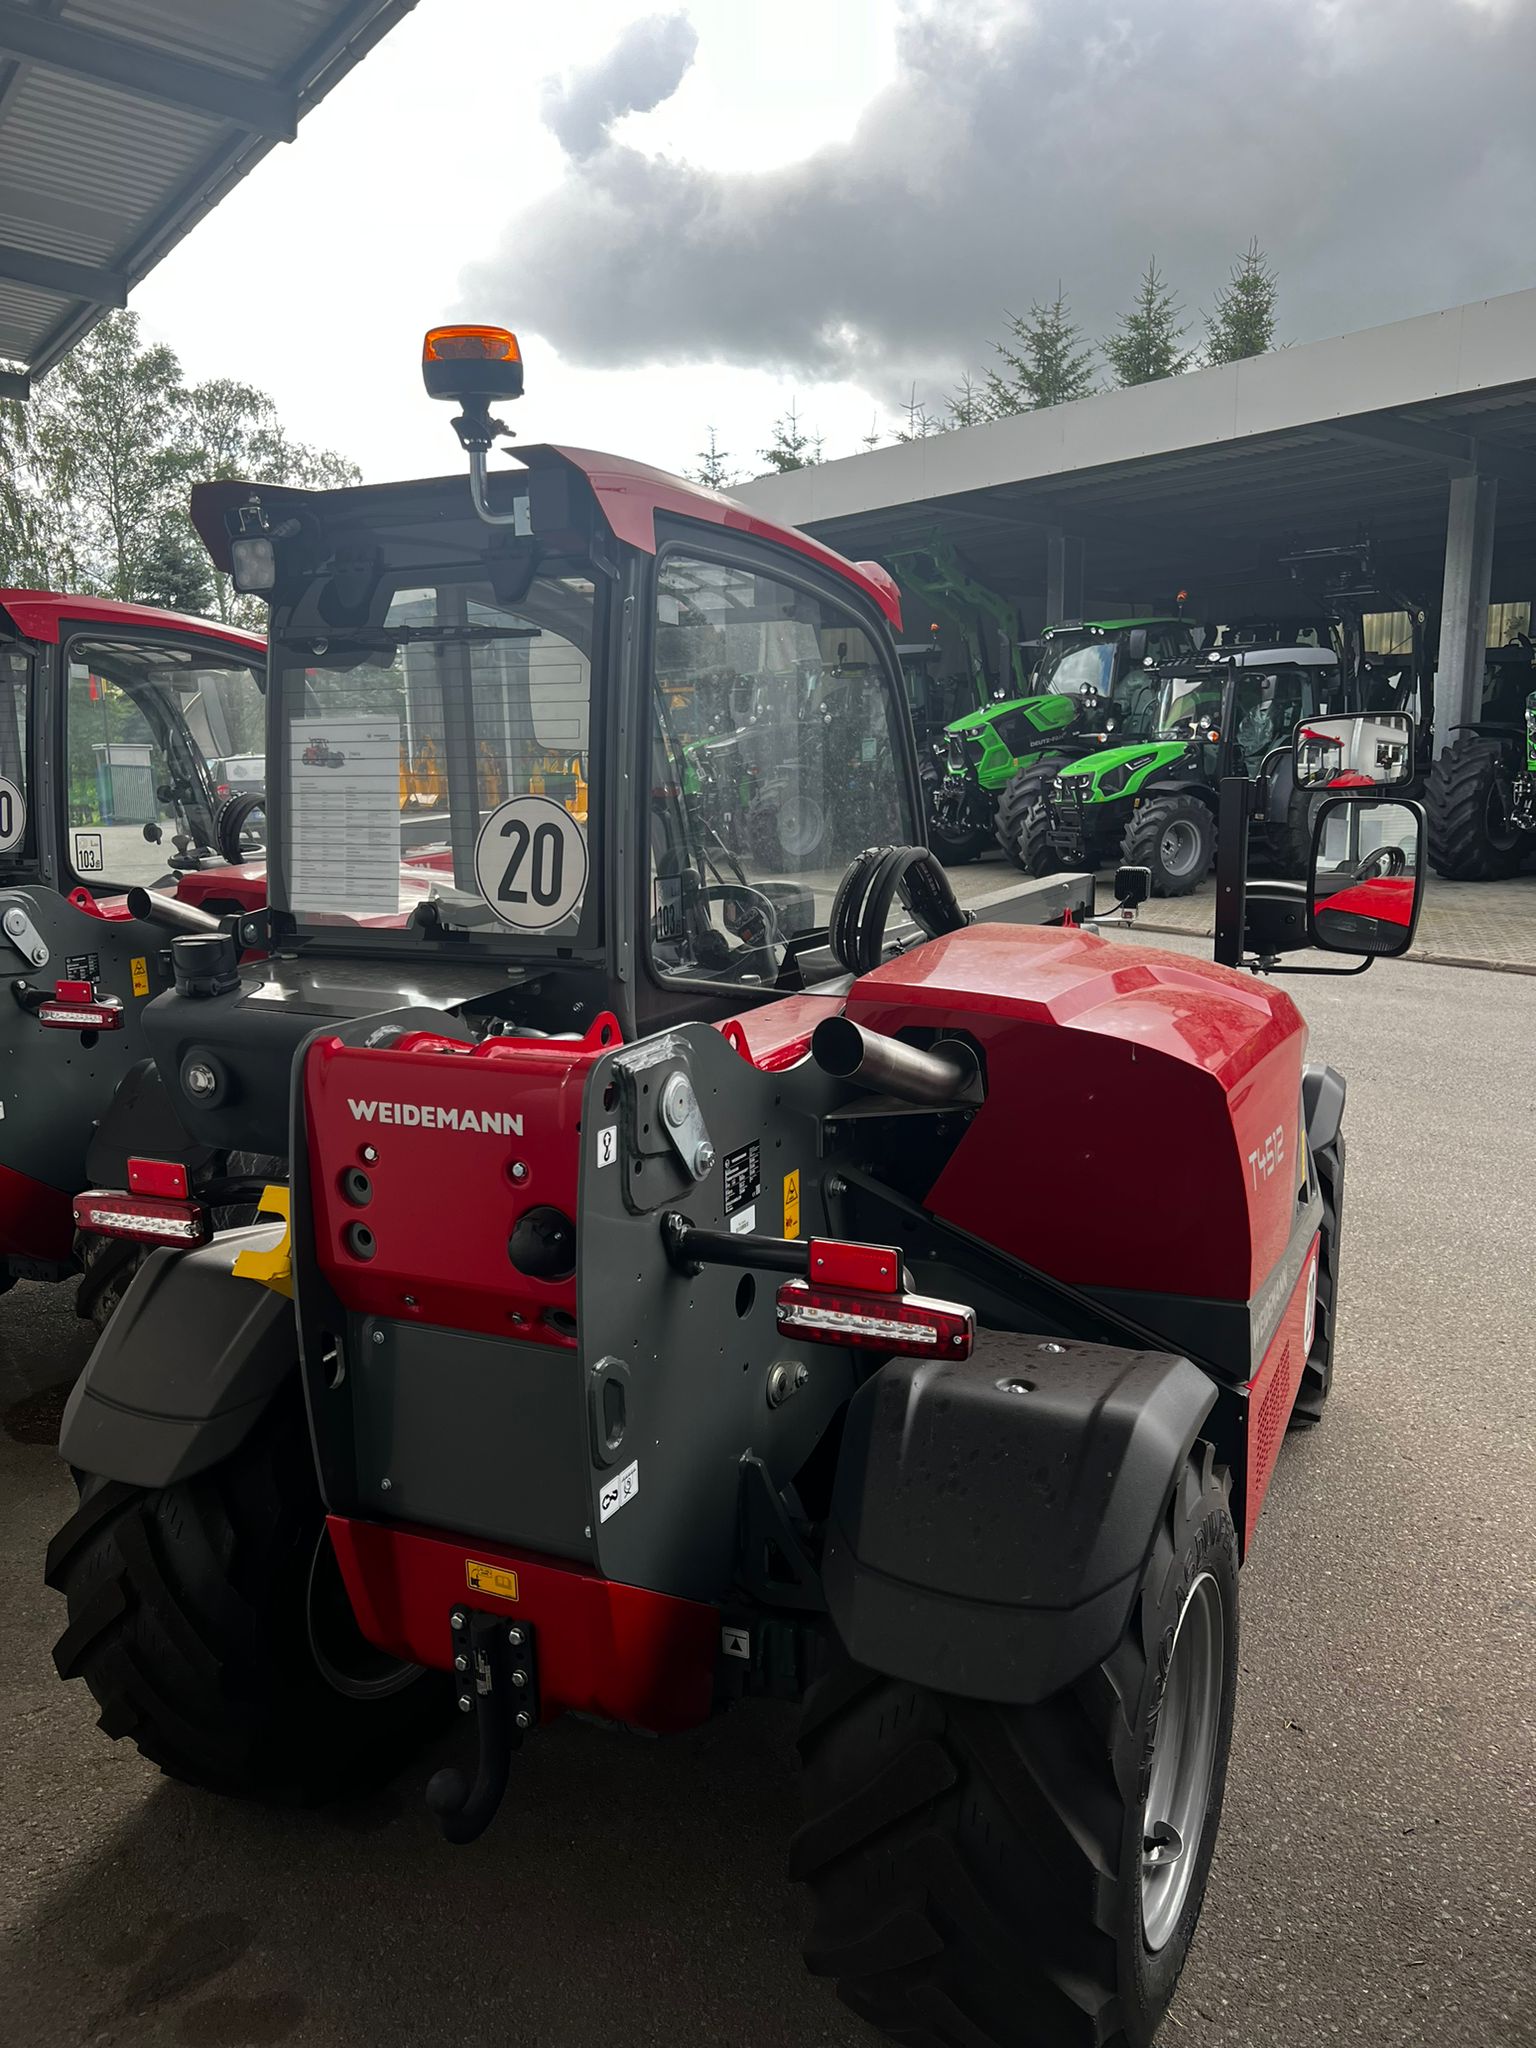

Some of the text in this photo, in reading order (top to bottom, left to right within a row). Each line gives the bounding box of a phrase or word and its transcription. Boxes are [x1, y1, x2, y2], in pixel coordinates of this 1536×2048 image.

[79, 850, 95, 868] 103
[497, 818, 565, 907] 20
[346, 1098, 524, 1137] WEIDEMANN
[1248, 1124, 1285, 1192] T4512
